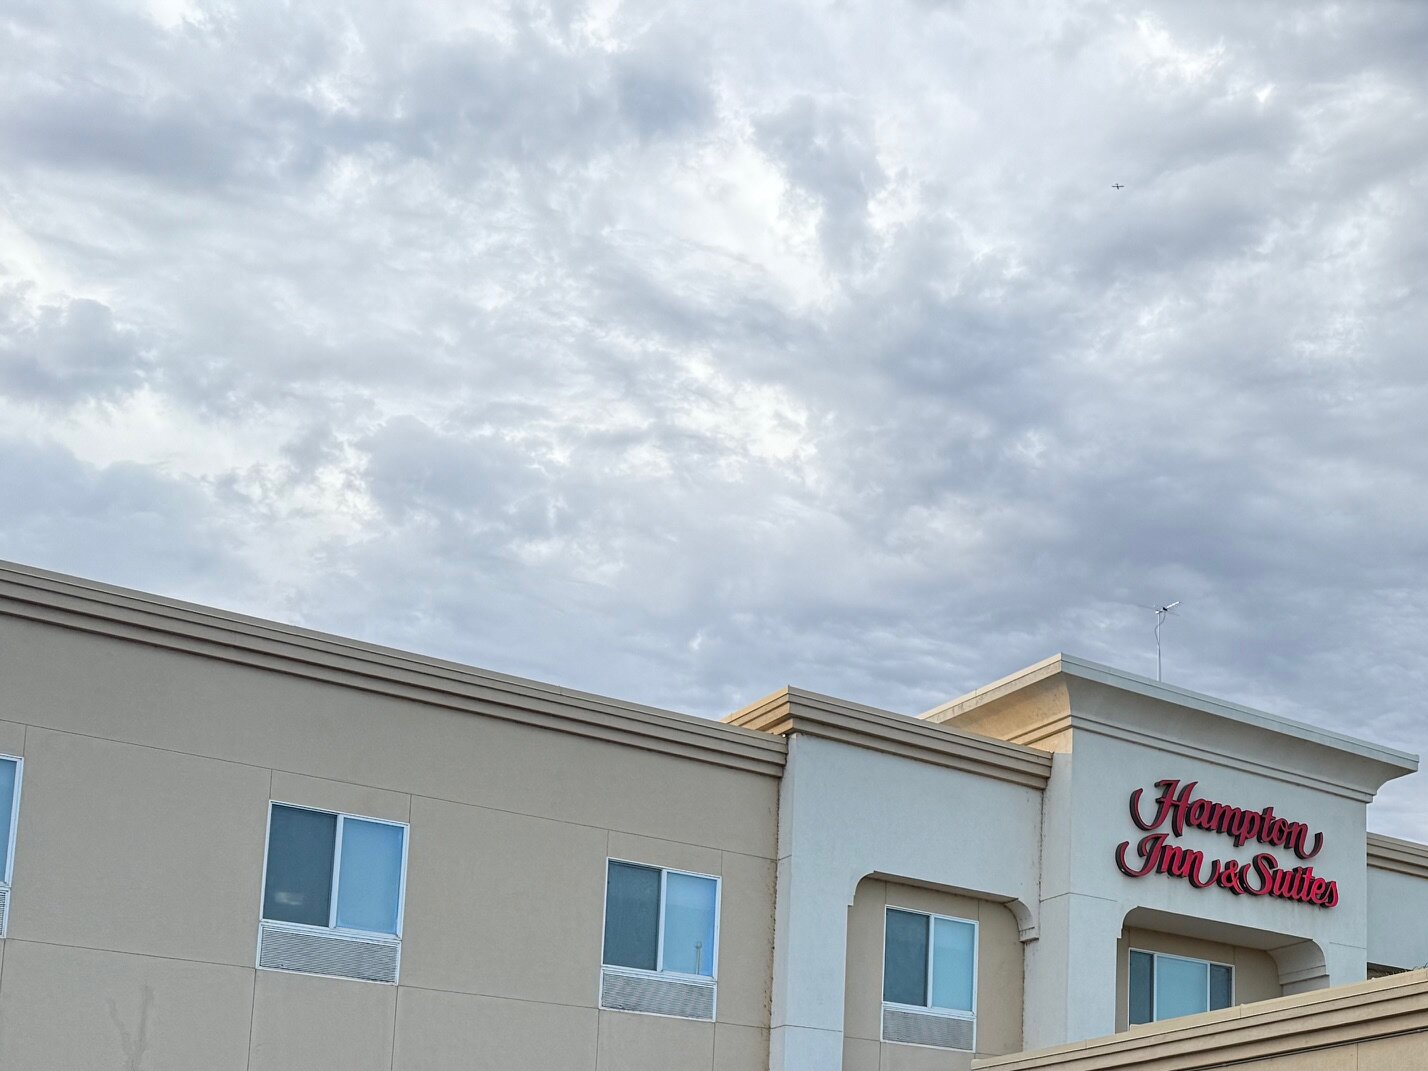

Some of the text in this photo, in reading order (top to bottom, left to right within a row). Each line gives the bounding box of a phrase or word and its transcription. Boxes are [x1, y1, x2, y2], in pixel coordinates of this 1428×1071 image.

[1129, 779, 1323, 860] Hampton
[1115, 832, 1339, 908] Inn & Suites
